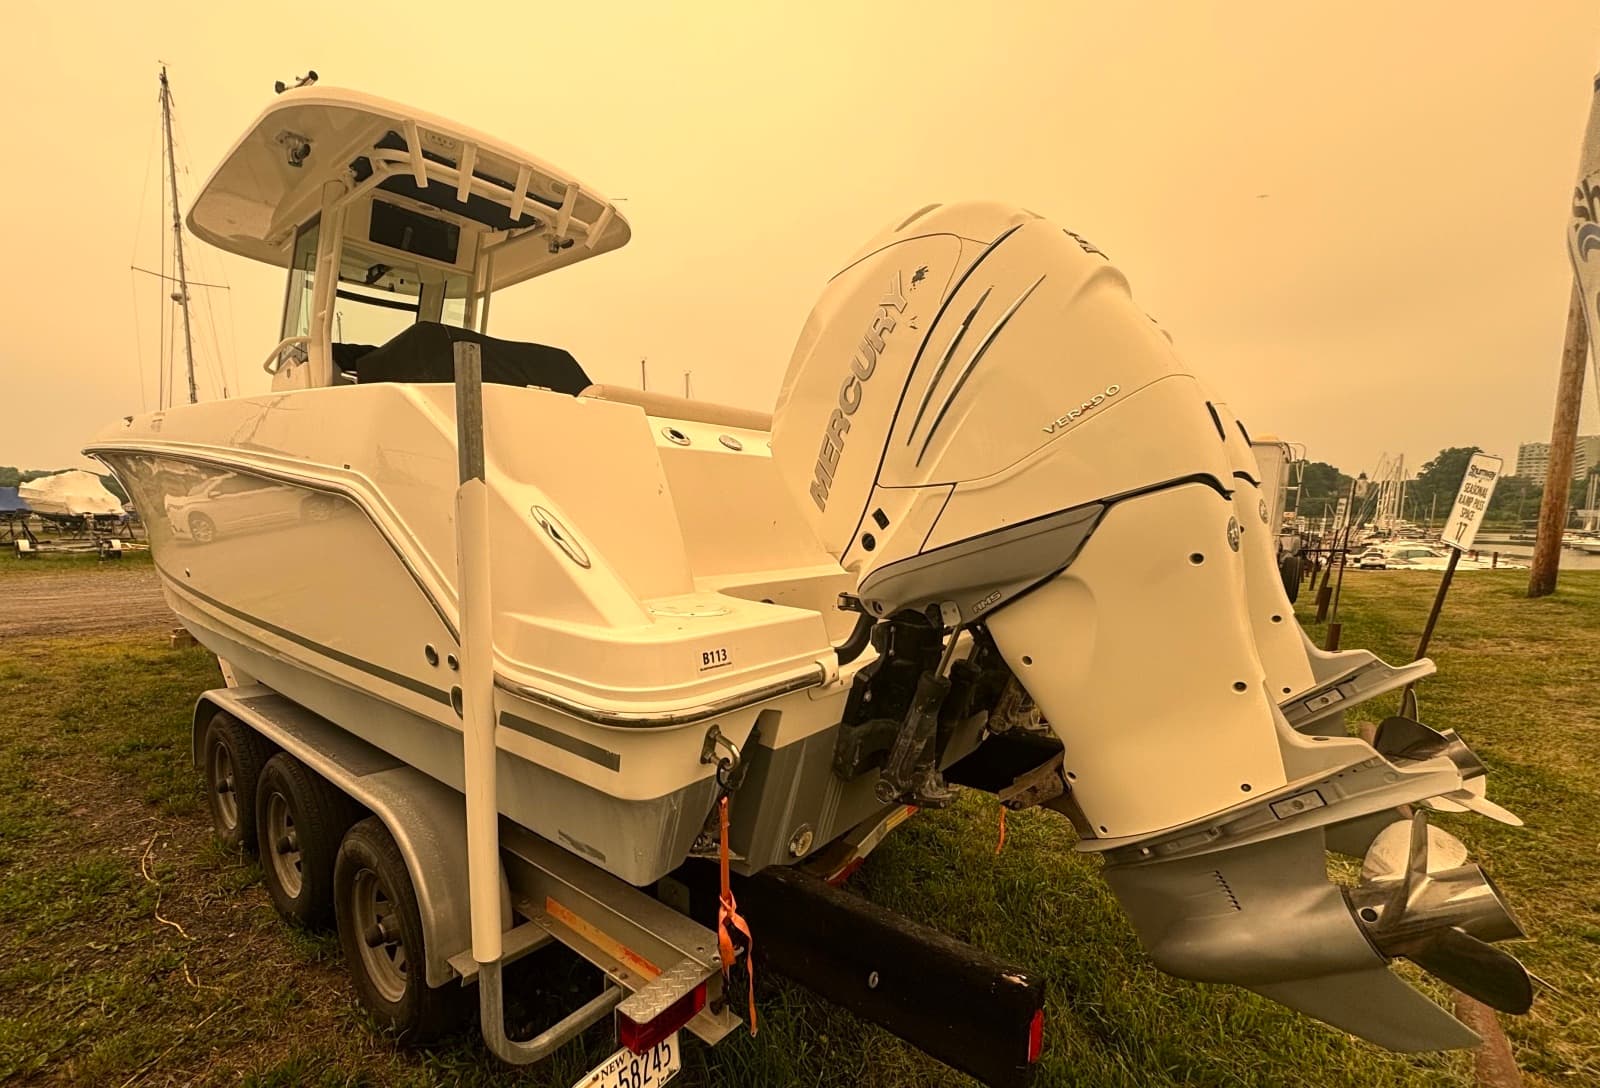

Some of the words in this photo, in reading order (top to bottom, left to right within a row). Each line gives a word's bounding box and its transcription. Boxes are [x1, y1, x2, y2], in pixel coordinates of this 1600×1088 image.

[809, 270, 909, 512] MERCURY
[1042, 384, 1121, 435] VERADO
[1464, 483, 1488, 498] SEASONAL
[1458, 494, 1474, 507] RAMP
[1473, 498, 1485, 511] PASS
[1460, 508, 1475, 521] SPACE
[702, 648, 728, 666] B113
[600, 1054, 625, 1081] NEW
